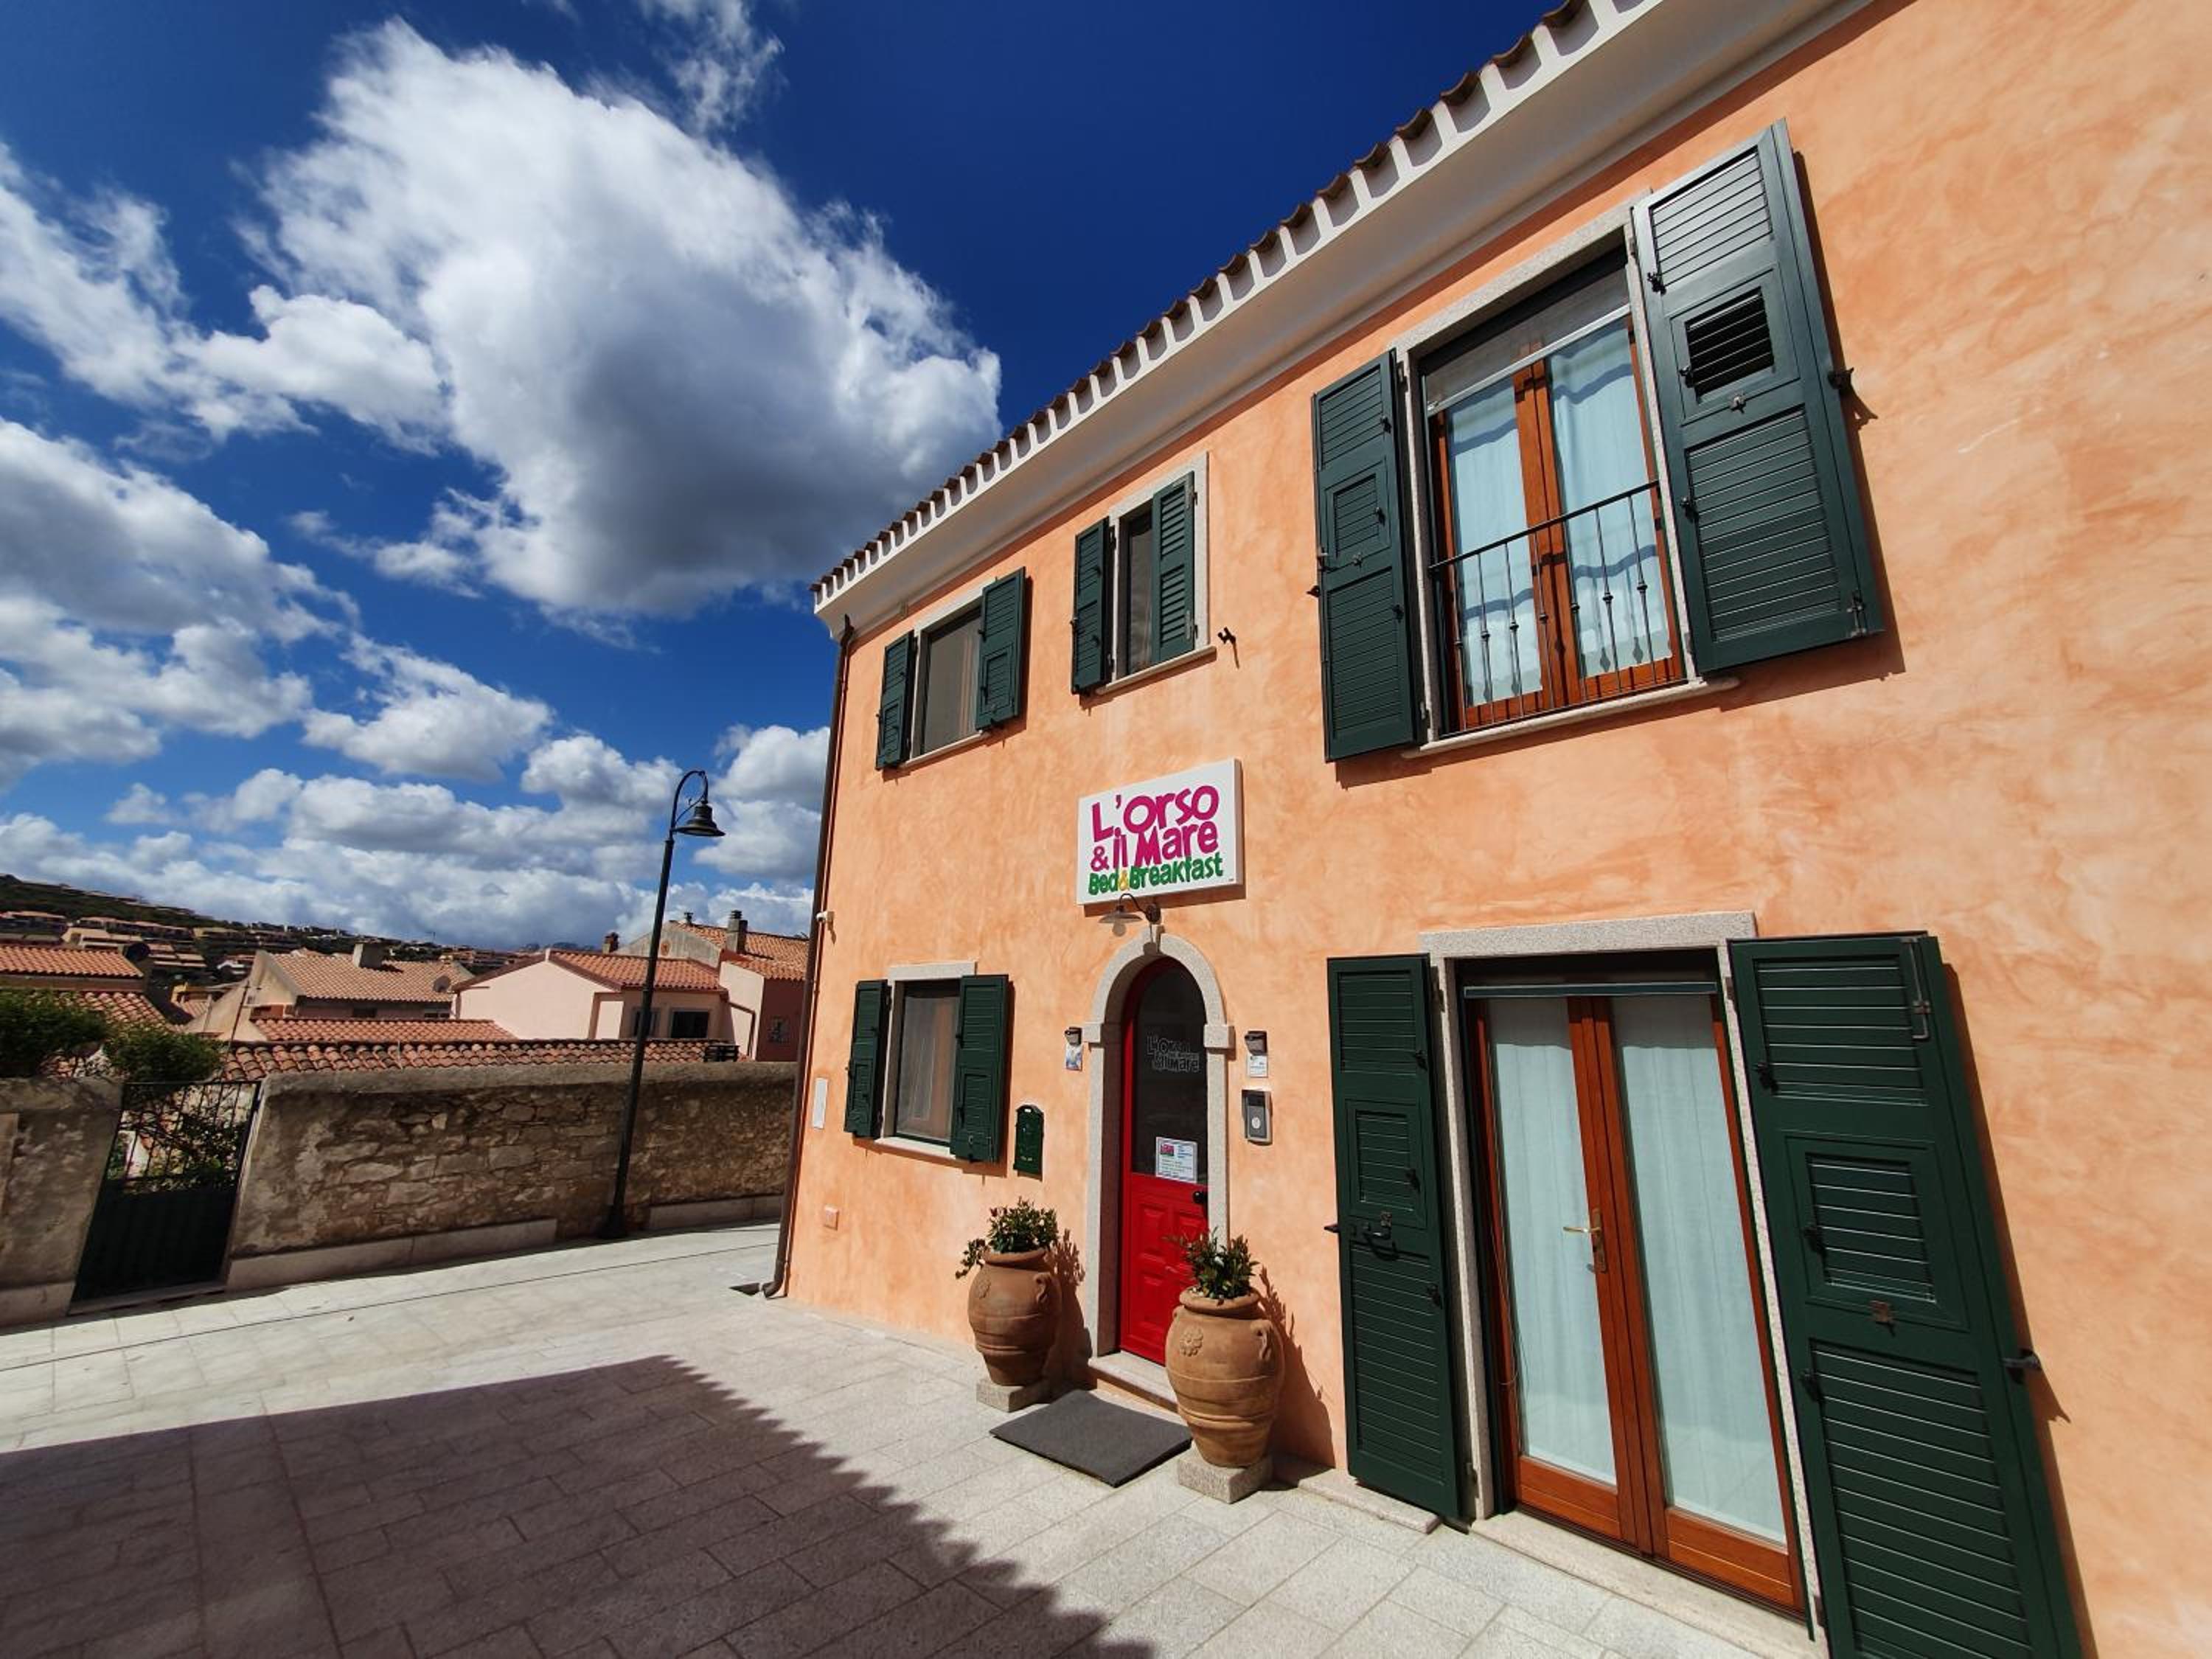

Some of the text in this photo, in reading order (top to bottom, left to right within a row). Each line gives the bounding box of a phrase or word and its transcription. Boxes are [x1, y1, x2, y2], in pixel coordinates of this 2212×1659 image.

[1092, 785, 1219, 842] L'Orso
[1090, 821, 1218, 872] & il Mare
